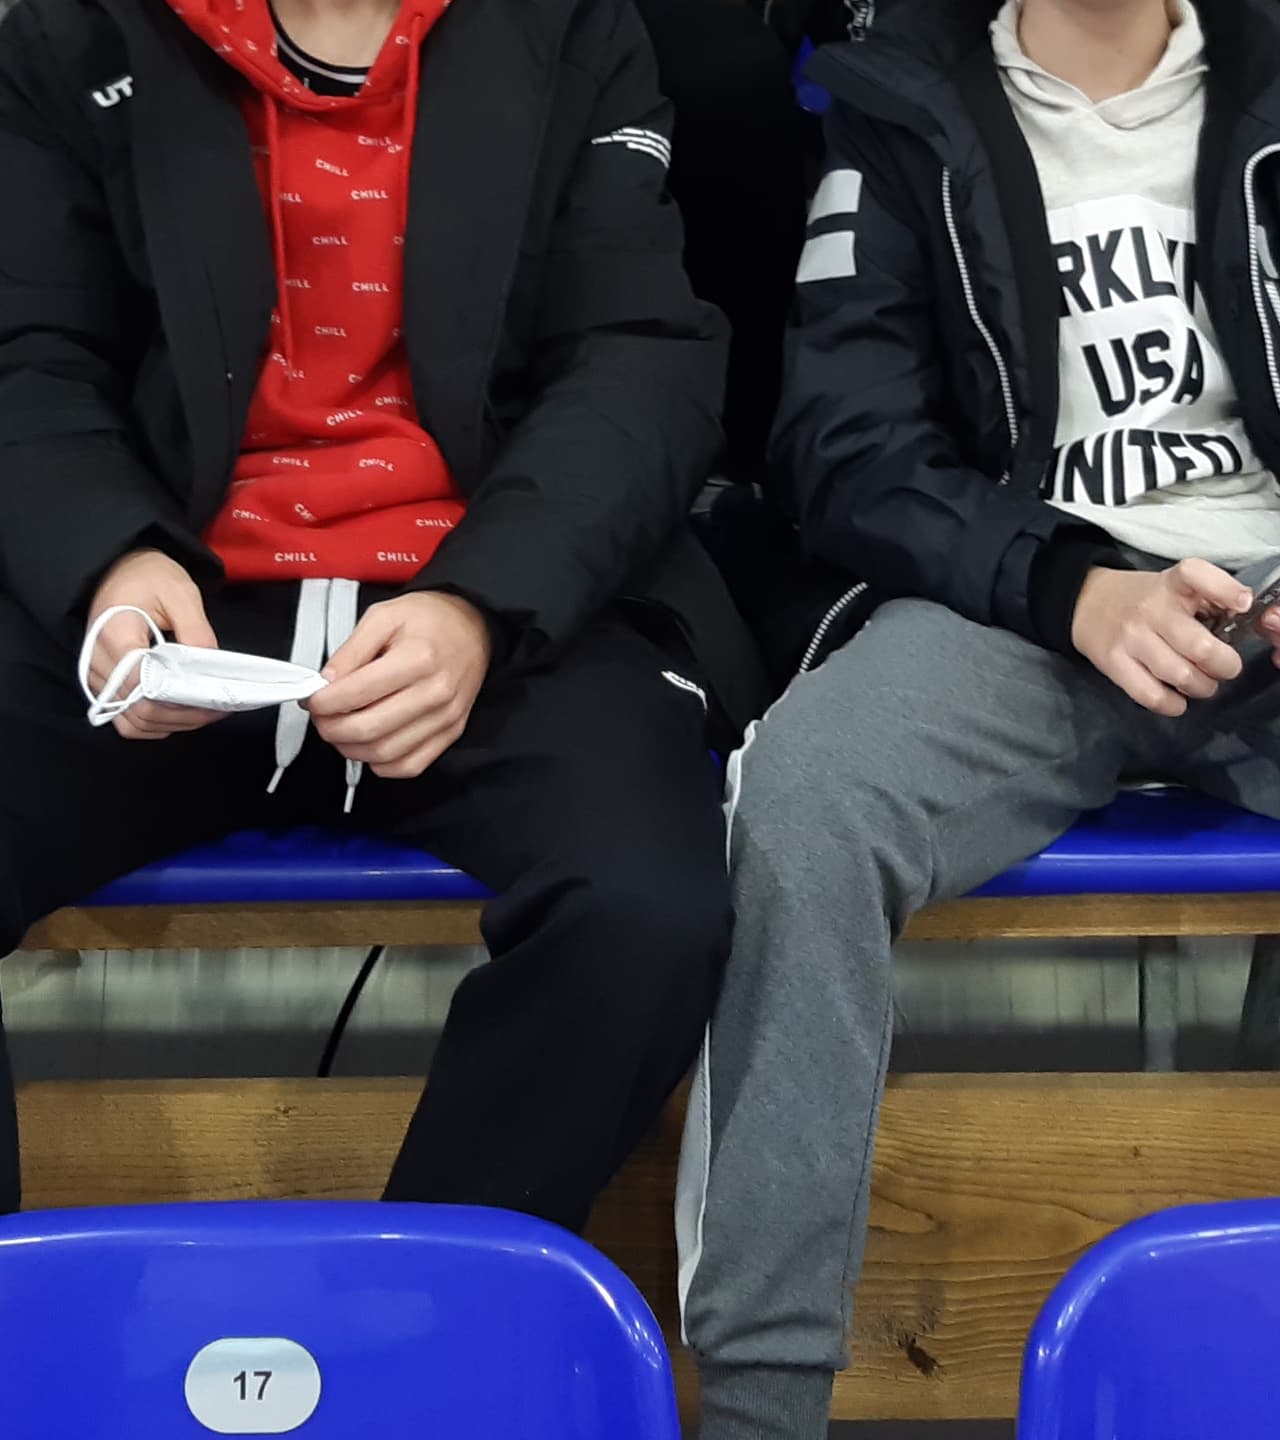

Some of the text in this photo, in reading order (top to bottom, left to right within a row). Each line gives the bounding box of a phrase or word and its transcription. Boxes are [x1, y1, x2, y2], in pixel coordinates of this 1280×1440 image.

[351, 189, 388, 200] CHILL
[312, 236, 348, 245] CHILL
[351, 281, 390, 293] CHILL
[1080, 326, 1205, 418] USA
[272, 456, 311, 468] CHILL
[416, 518, 456, 529] CHILL
[274, 552, 317, 563] CHILL
[377, 551, 420, 563] CHILL
[233, 1370, 273, 1401] 17
